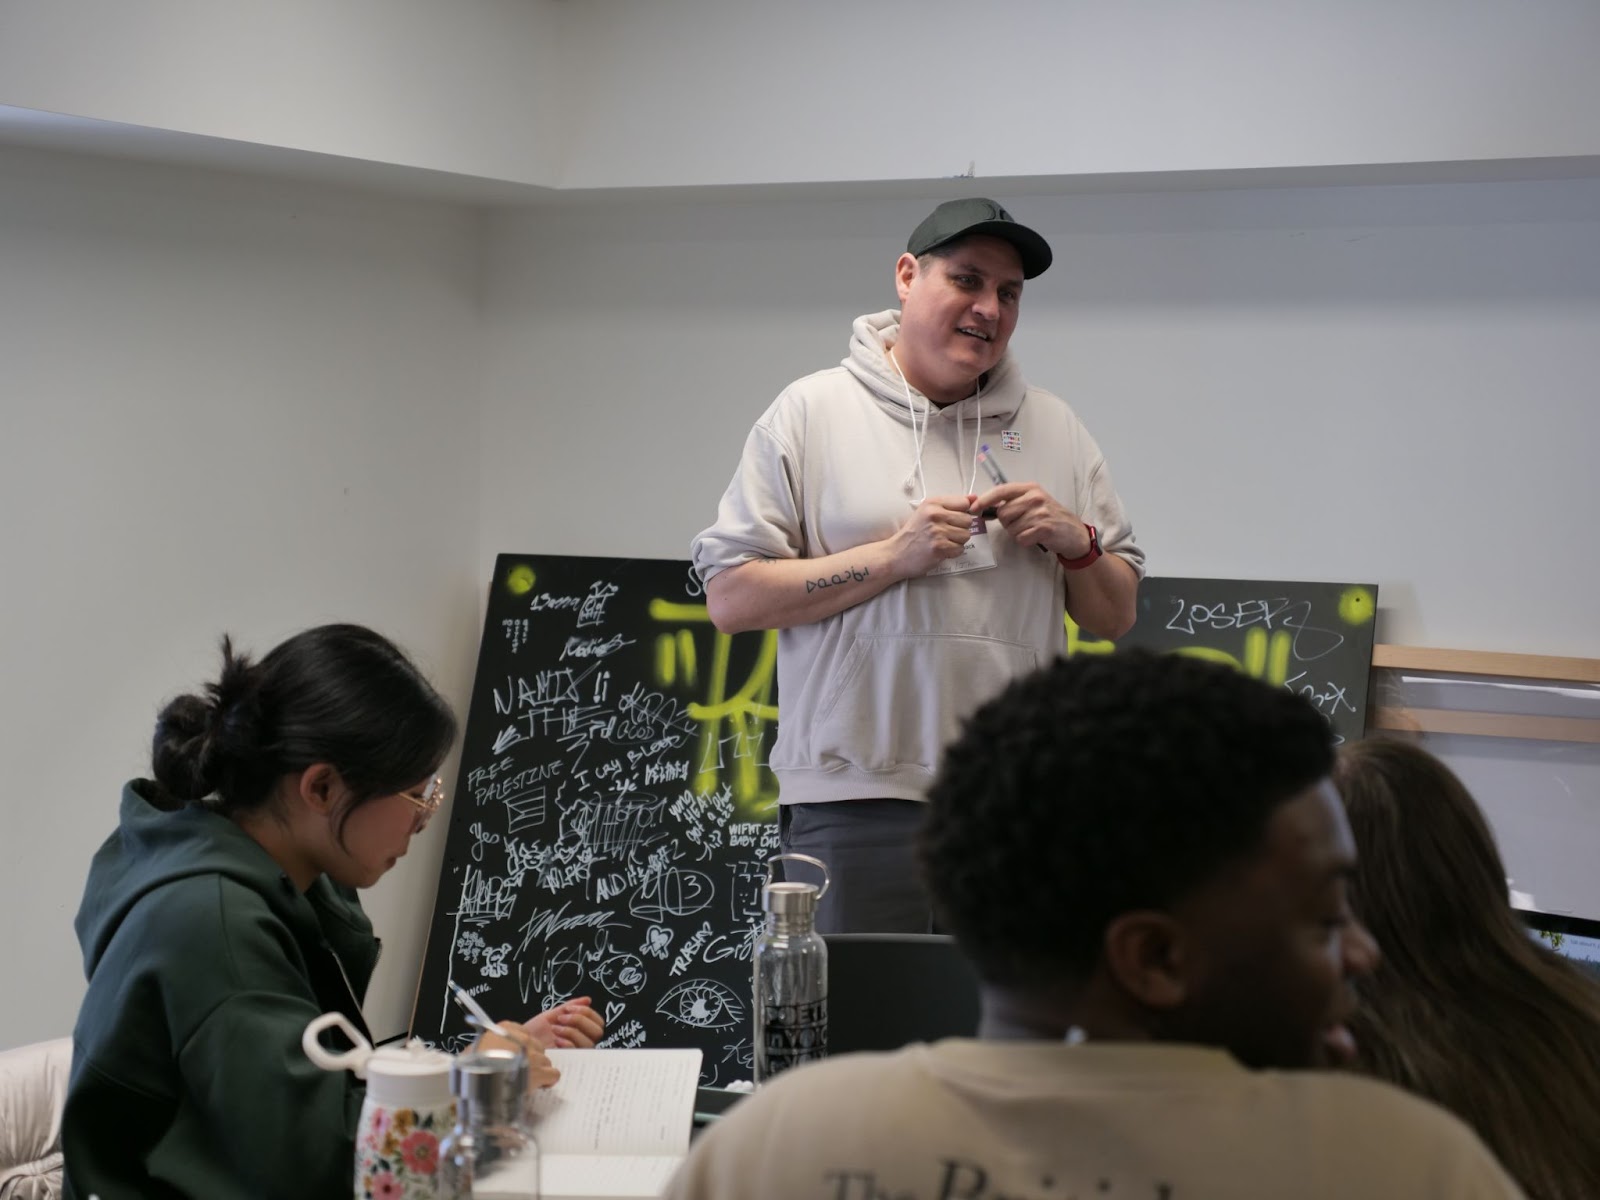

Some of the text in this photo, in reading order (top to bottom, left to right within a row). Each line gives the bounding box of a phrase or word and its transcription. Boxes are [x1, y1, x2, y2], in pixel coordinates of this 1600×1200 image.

[467, 756, 515, 792] FREE
[474, 760, 564, 806] PALESTINE
[729, 835, 757, 847] BABY
